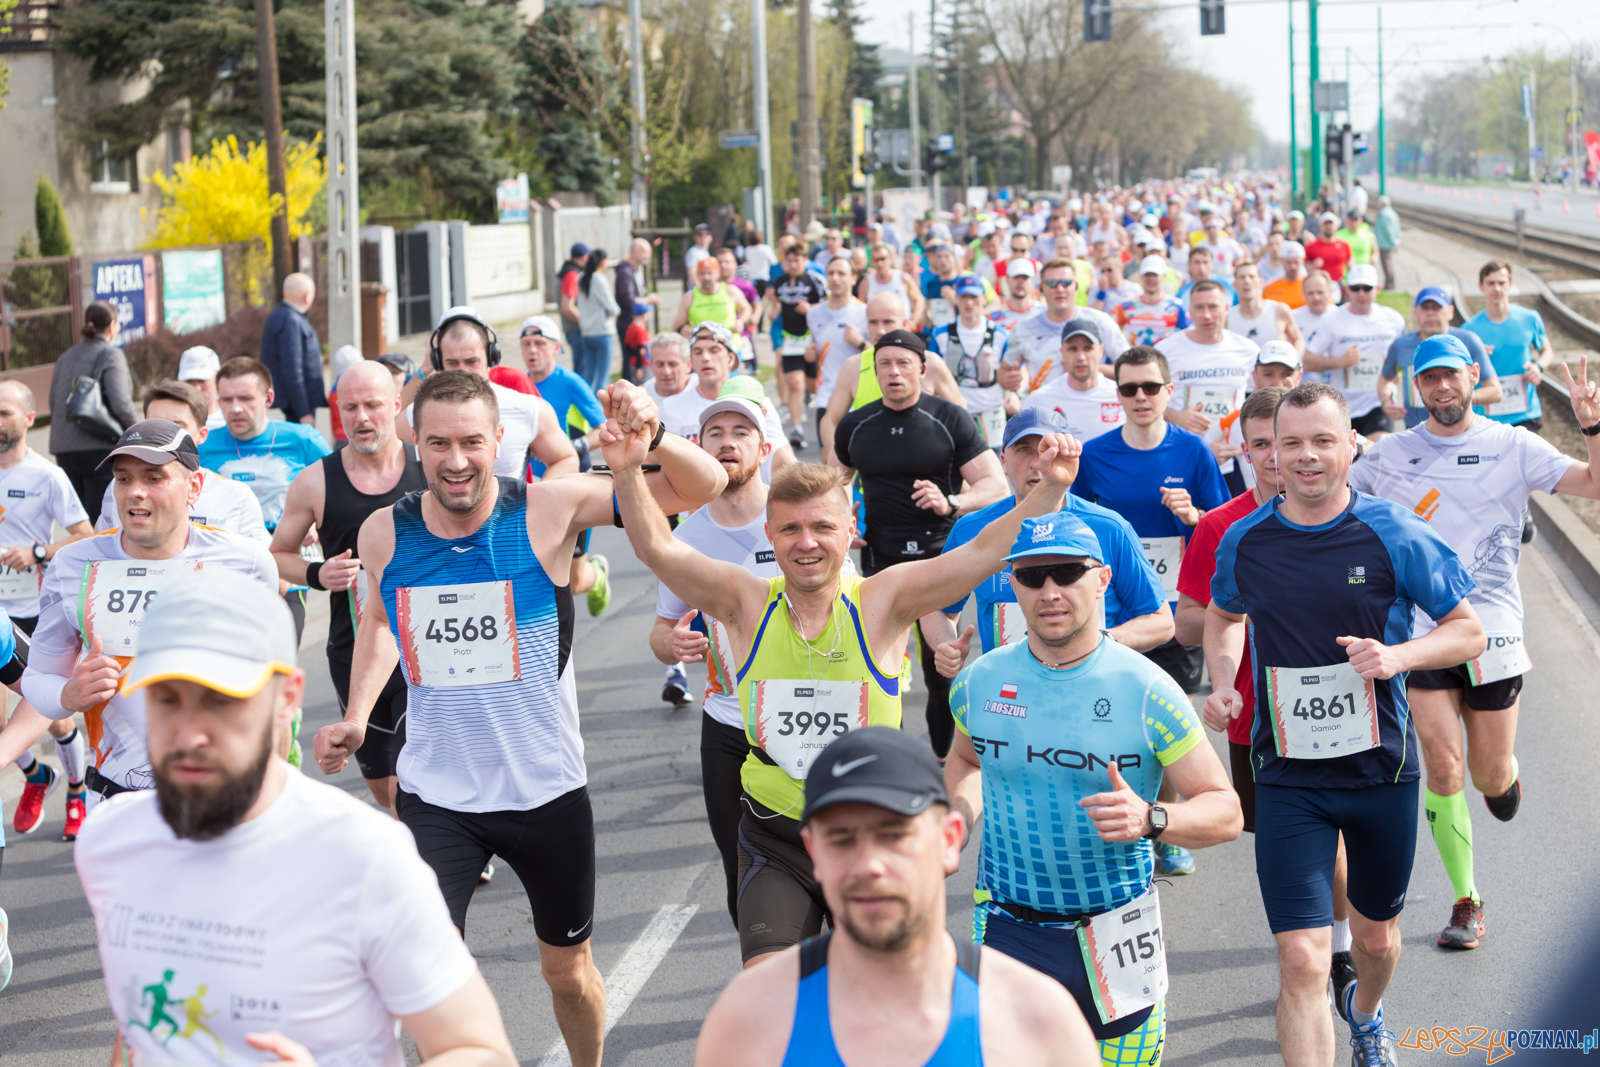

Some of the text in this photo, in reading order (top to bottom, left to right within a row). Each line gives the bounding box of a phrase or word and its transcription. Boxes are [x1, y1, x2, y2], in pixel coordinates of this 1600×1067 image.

[97, 264, 144, 294] APTEKA
[425, 615, 498, 643] 4568
[984, 700, 1028, 718] J. ROSZUK
[1293, 692, 1356, 720] 4861
[777, 711, 849, 736] 3995
[1311, 724, 1342, 732] Damian
[799, 741, 827, 749] Janusz
[1027, 744, 1142, 772] KONA
